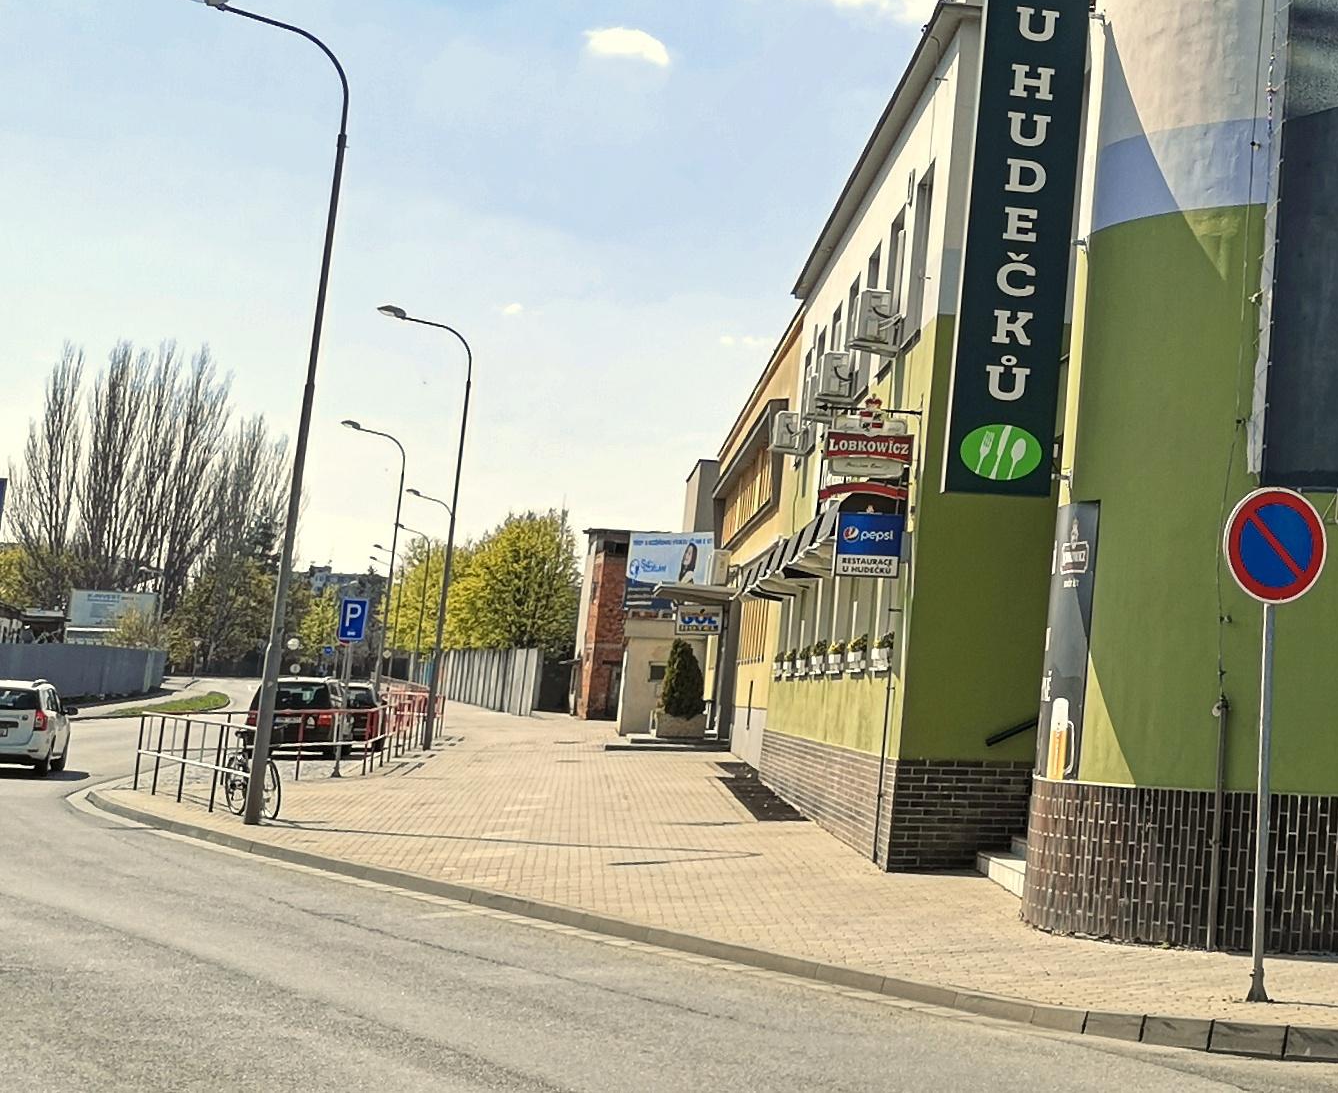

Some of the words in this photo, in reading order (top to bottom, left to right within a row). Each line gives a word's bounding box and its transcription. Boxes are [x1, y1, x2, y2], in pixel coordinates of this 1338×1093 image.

[1016, 7, 1059, 42] U
[986, 63, 1055, 401] HUDEČKŮ
[828, 437, 910, 455] LOBKOWICZ
[860, 529, 894, 542] pepsi
[842, 557, 892, 566] RESTAURACE
[345, 603, 361, 627] P
